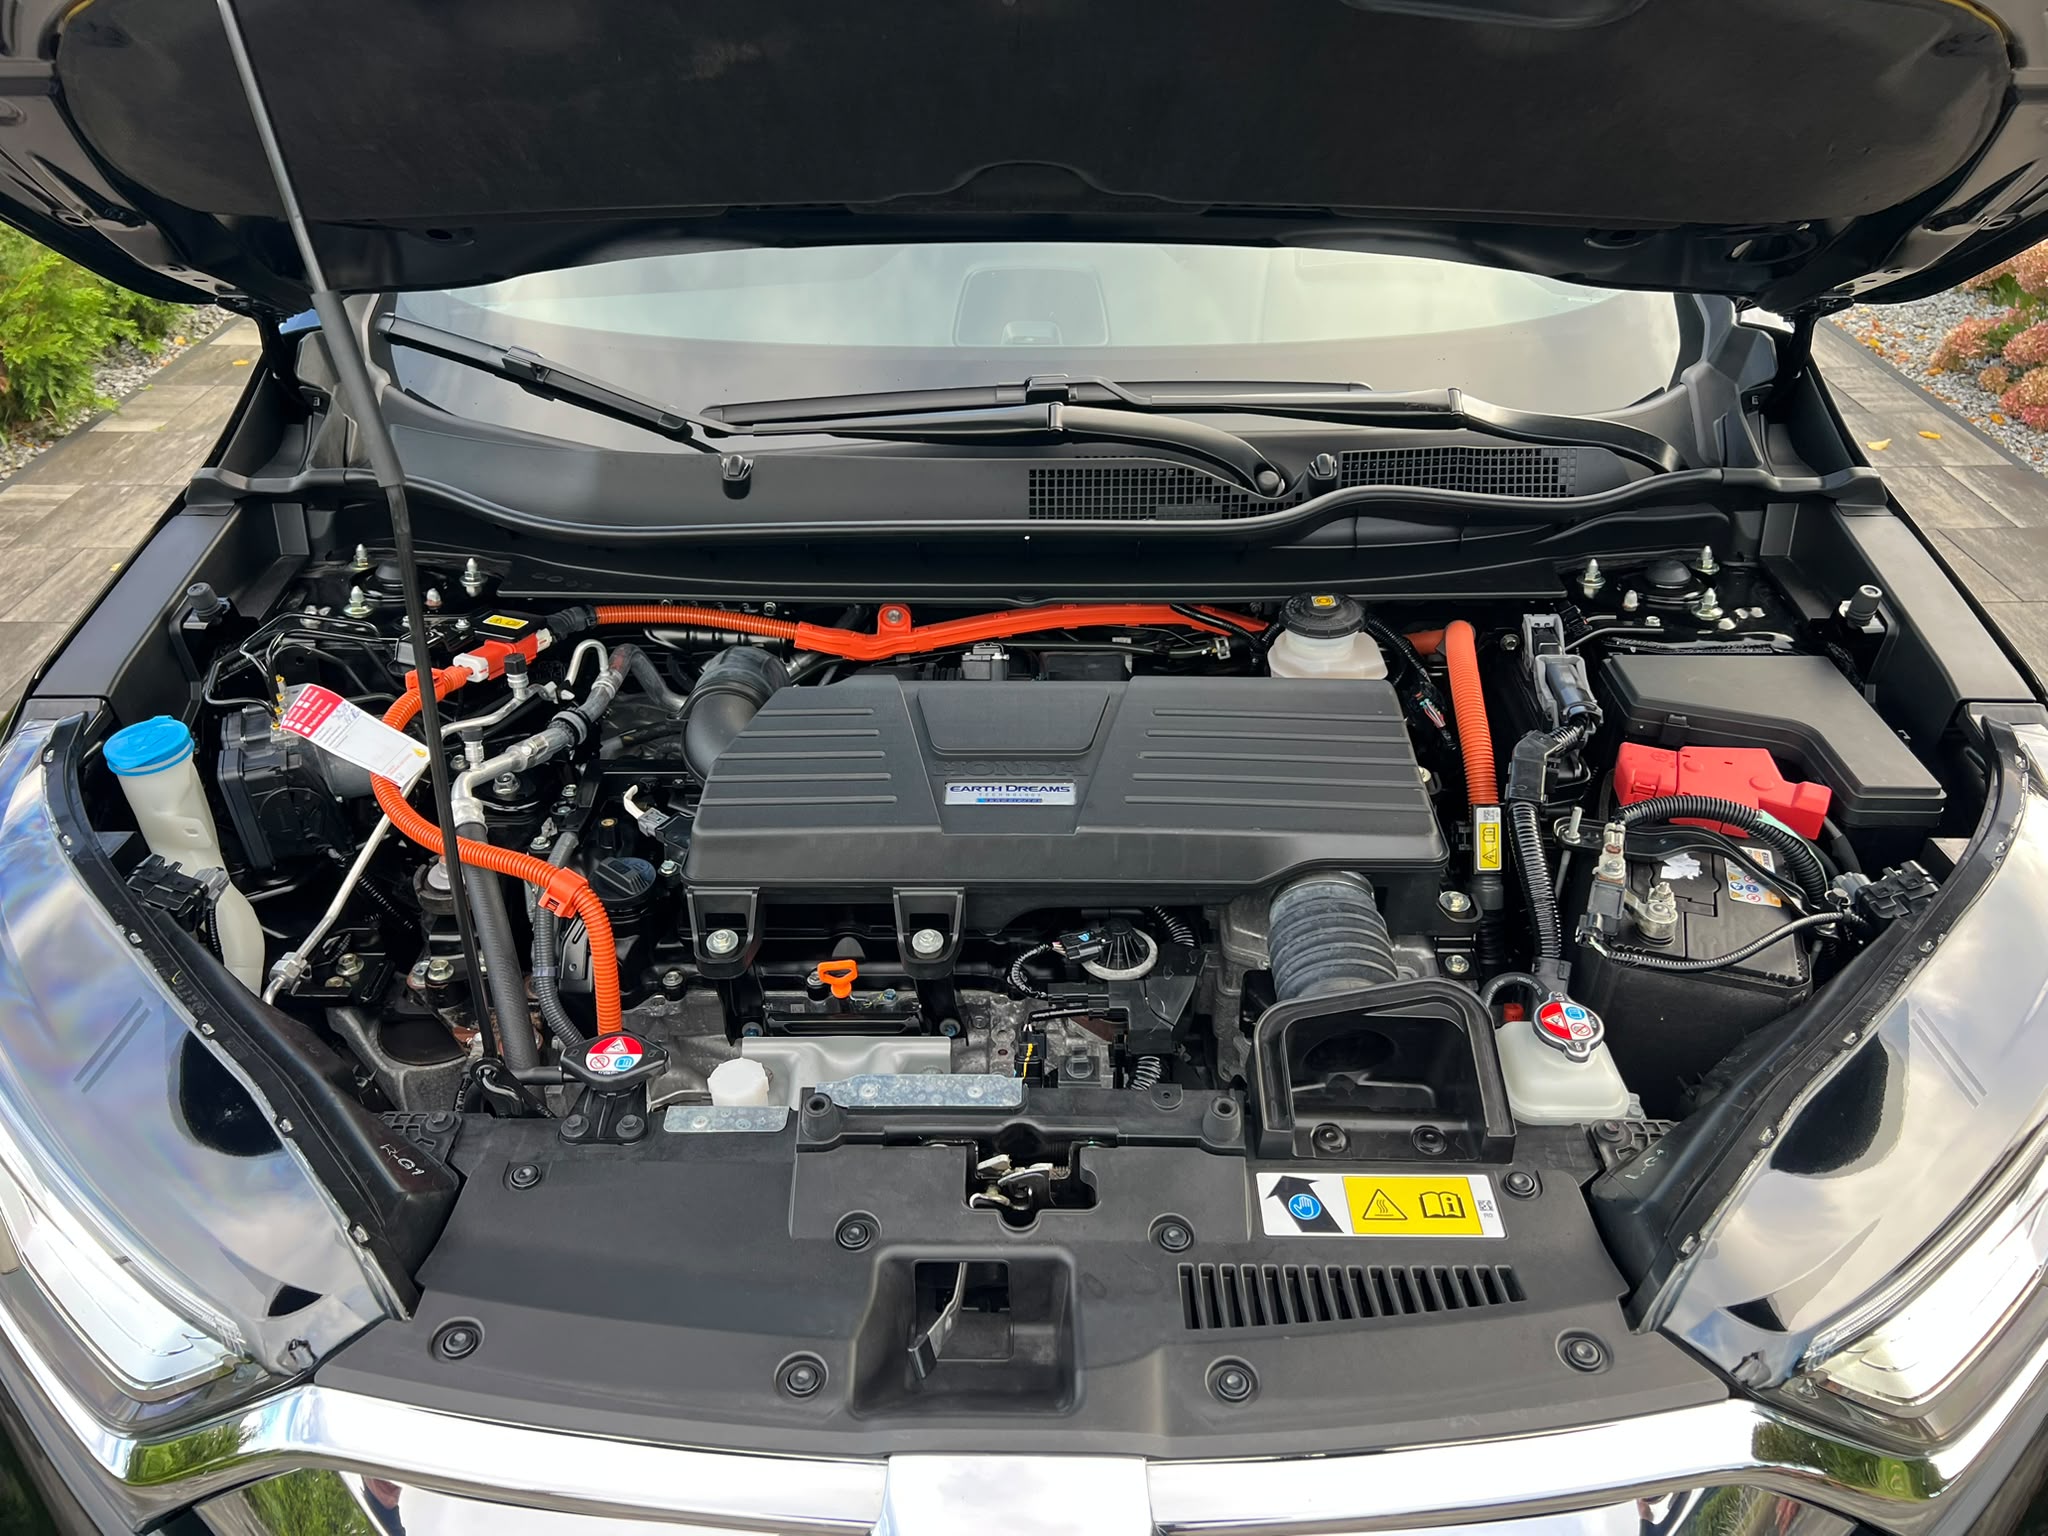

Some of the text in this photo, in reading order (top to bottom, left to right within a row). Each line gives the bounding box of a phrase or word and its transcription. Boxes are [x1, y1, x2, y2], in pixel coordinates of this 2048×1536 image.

[931, 760, 1088, 776] HONDA
[950, 784, 1070, 793] EARTH DREAMS
